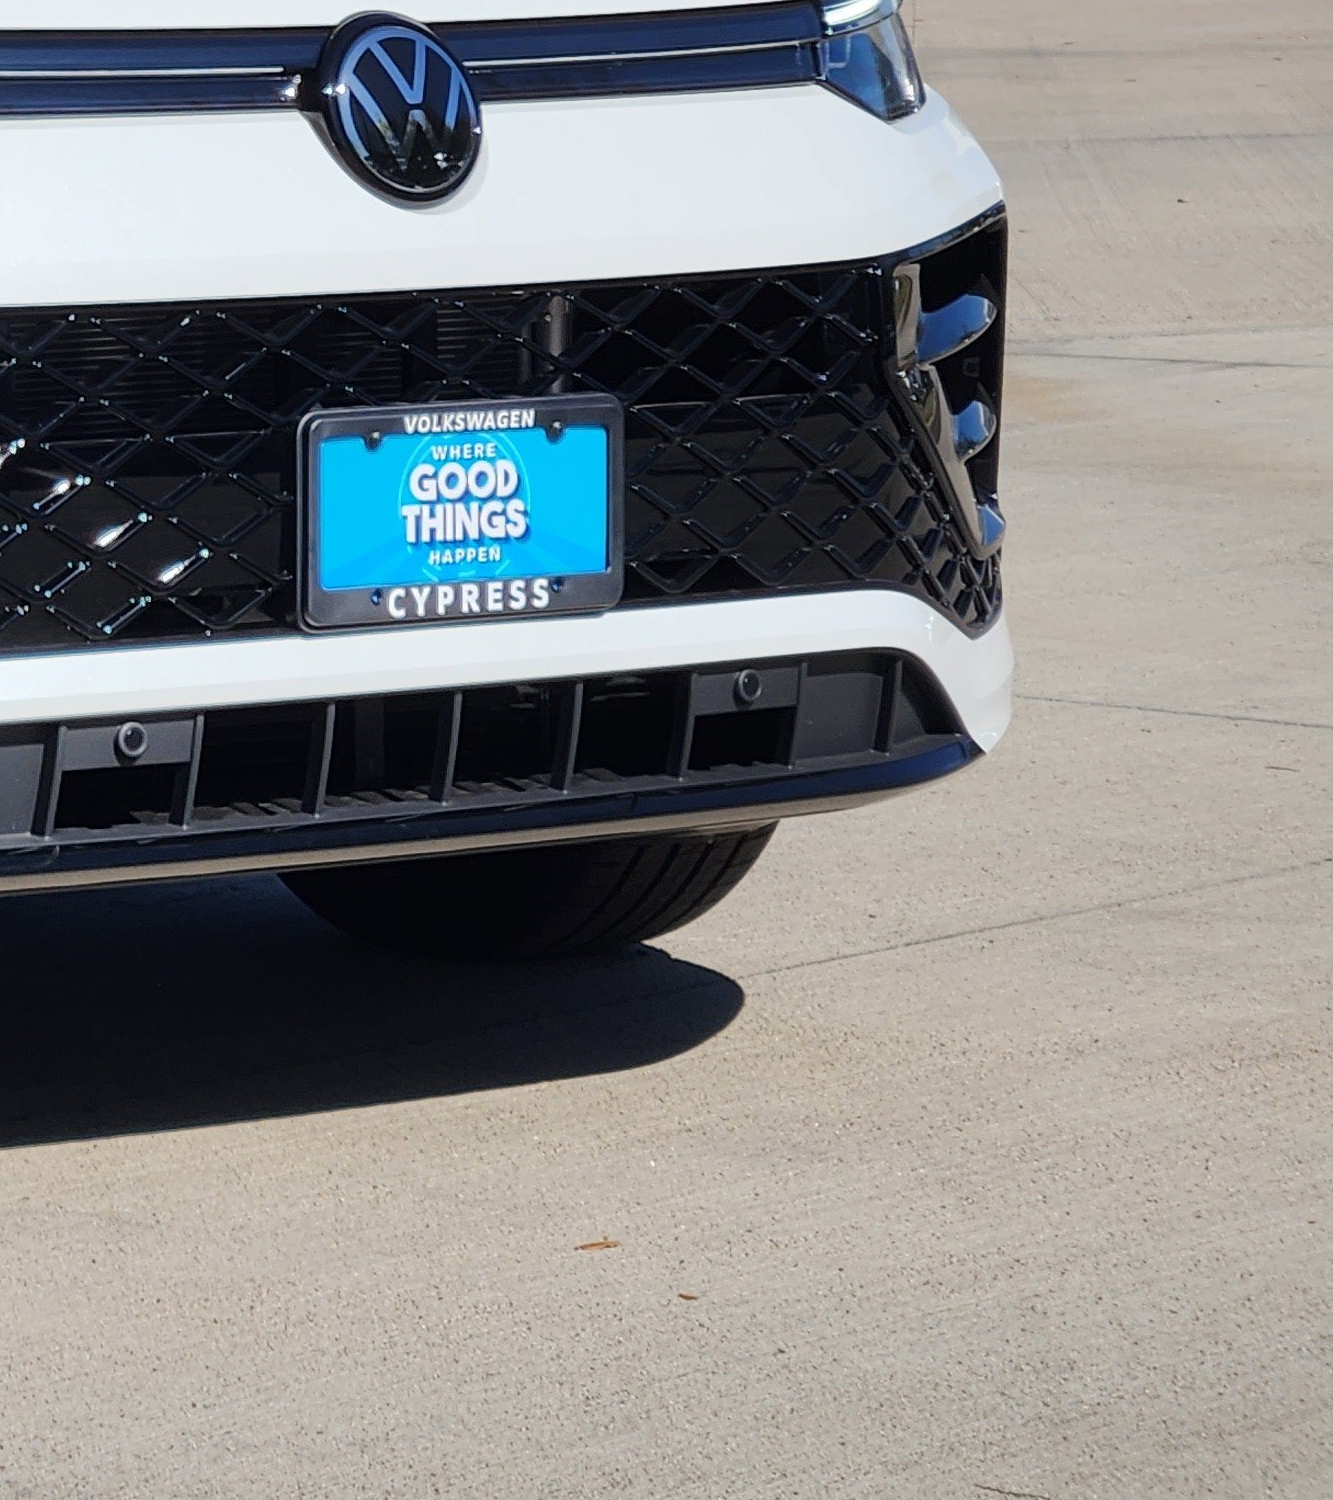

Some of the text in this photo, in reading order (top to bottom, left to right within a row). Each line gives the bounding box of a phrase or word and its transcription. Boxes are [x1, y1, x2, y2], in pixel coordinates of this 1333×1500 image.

[404, 409, 536, 434] VOLKSWAGEN
[432, 442, 497, 461] WHERE
[410, 459, 519, 502] GOOD
[401, 499, 529, 543] THINGS
[428, 546, 501, 565] HAPPEN
[388, 578, 551, 619] CYPRESS
